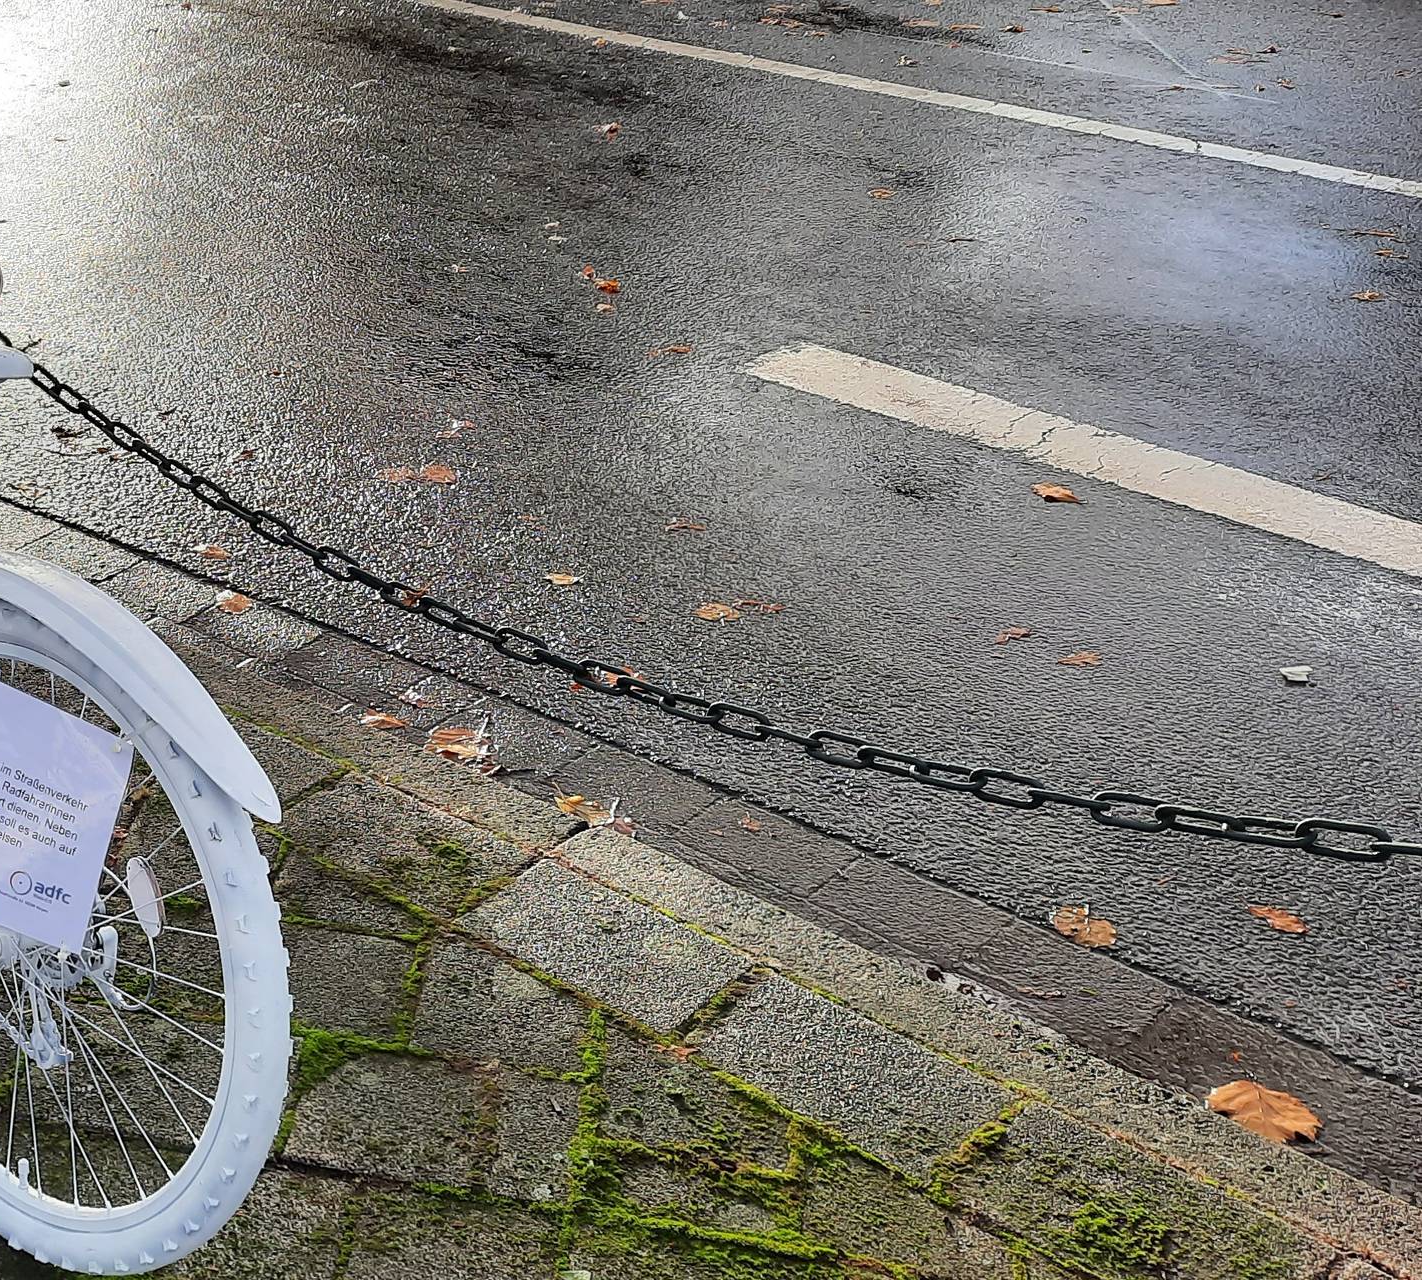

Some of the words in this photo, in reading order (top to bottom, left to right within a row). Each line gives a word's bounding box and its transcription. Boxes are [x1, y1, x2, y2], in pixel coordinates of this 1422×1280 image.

[0, 762, 12, 776] im
[14, 770, 88, 811] Straßenverkehr
[2, 780, 75, 823] Radfahrerinnen
[0, 815, 17, 829] soll
[18, 825, 30, 835] es
[32, 832, 56, 848] auch
[59, 844, 77, 856] auf
[45, 818, 77, 841] Neben
[34, 882, 71, 904] adfc
